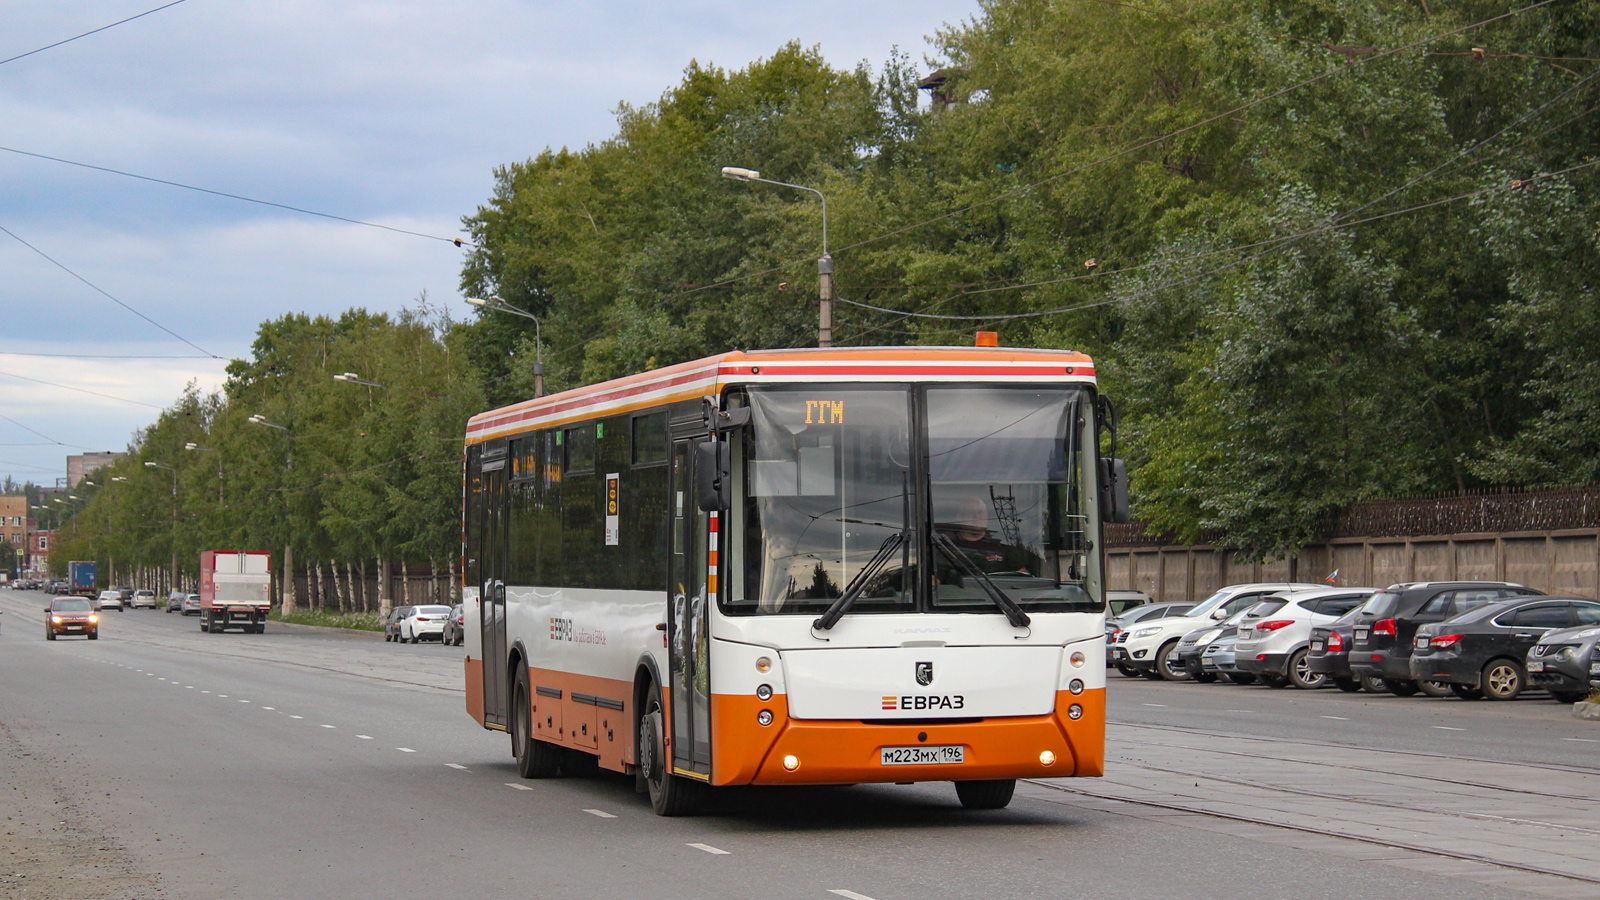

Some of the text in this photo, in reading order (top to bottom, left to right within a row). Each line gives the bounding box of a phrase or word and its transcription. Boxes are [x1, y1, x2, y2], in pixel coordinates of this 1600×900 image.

[555, 617, 573, 641] ЕВРАЗ
[901, 695, 965, 710] ЕВРАЗ
[941, 747, 961, 758] 196
